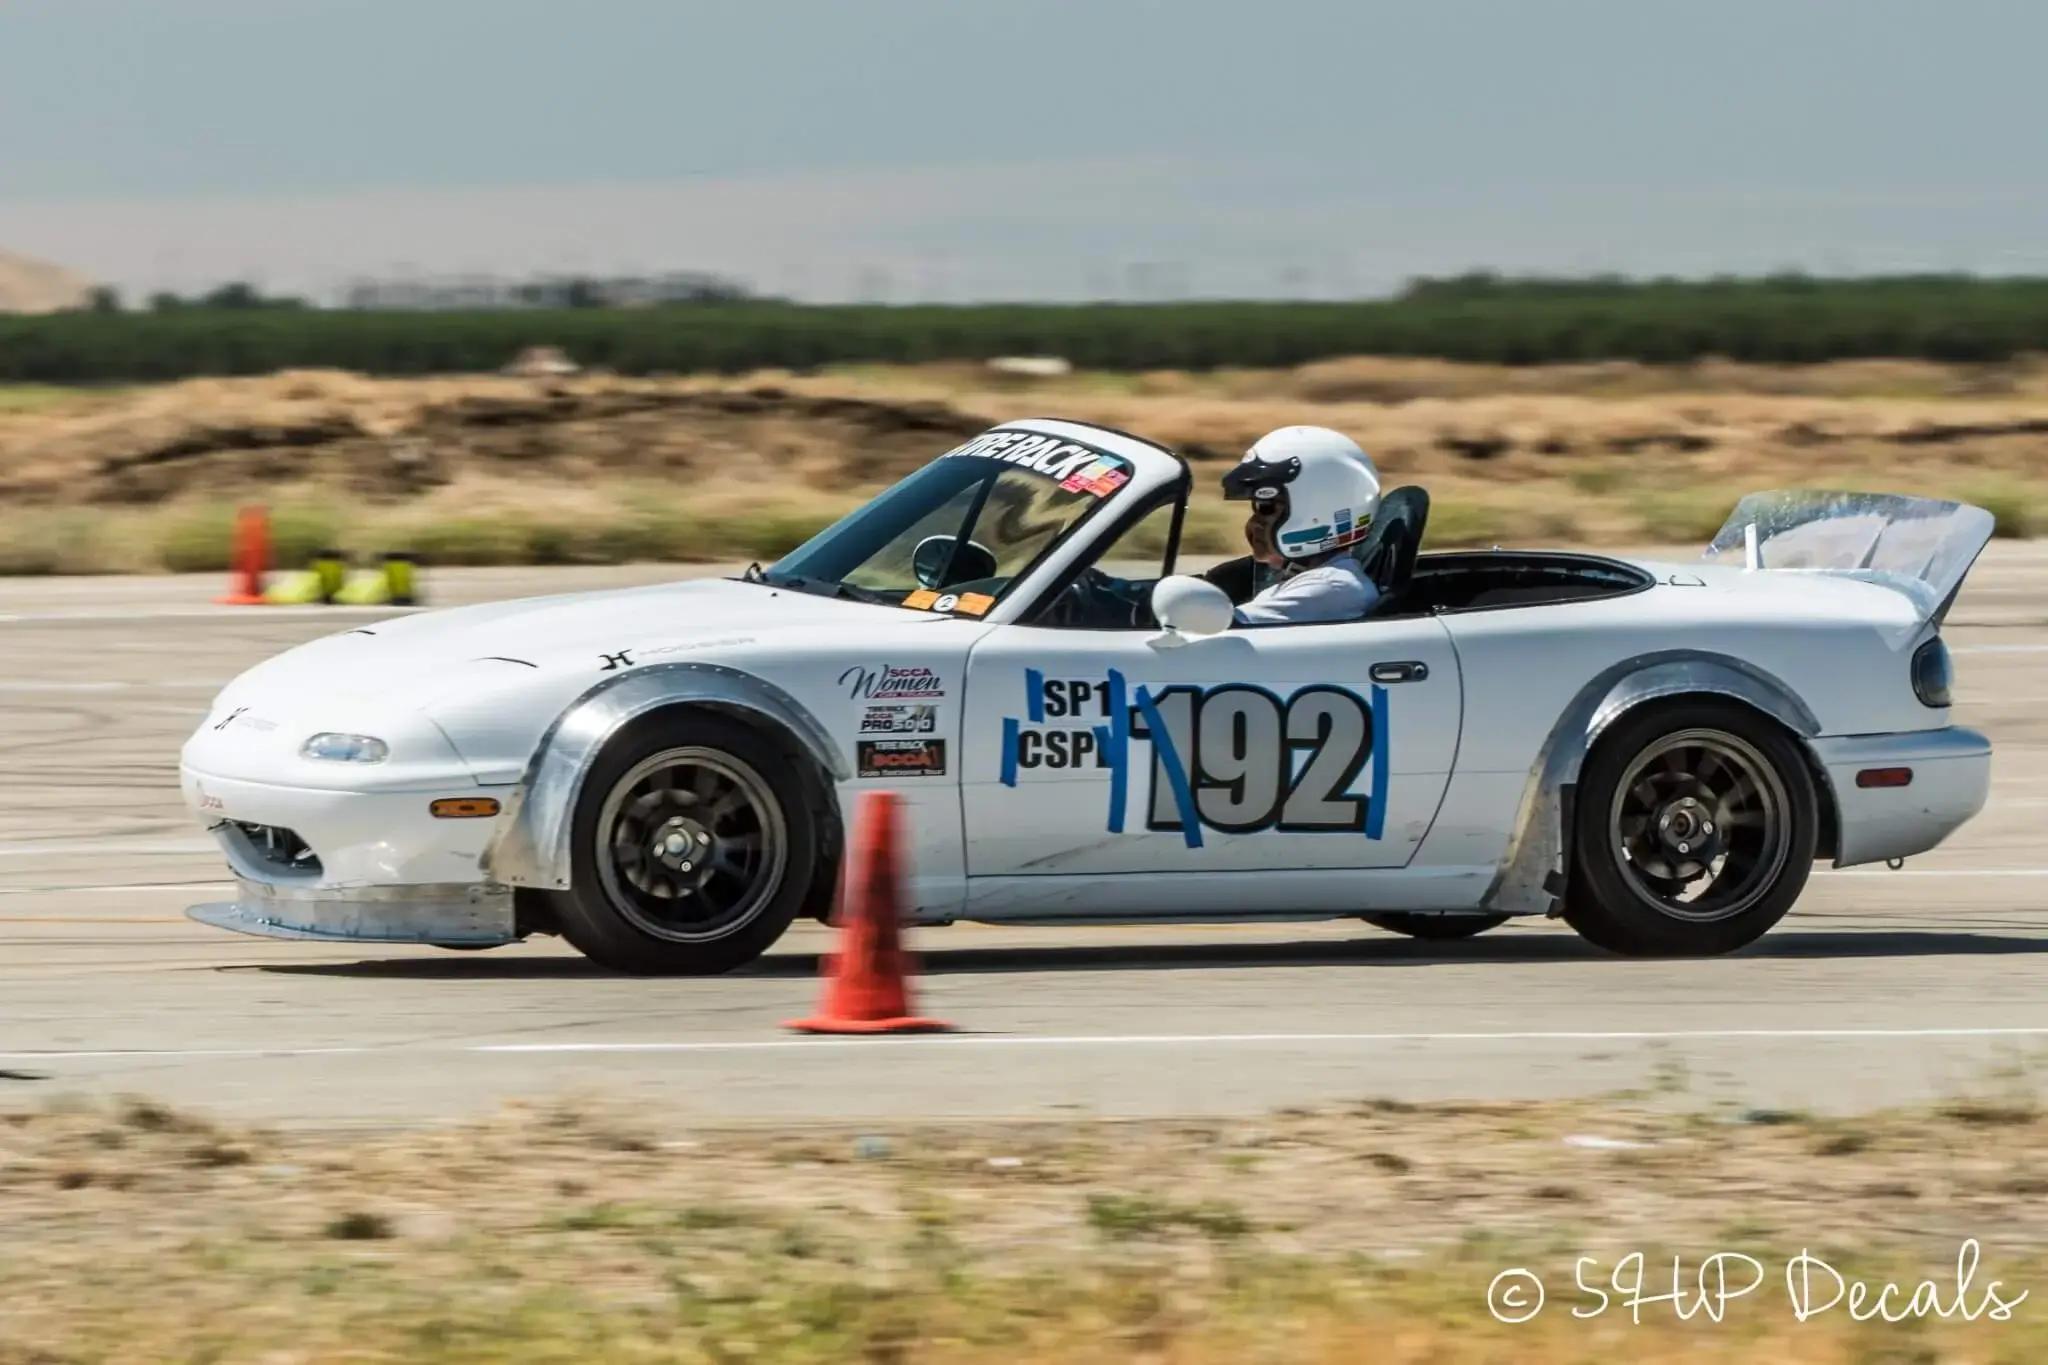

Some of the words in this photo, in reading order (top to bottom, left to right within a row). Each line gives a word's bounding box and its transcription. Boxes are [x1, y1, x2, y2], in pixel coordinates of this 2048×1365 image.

[838, 664, 942, 700] Women
[889, 668, 933, 677] SCCA
[1043, 680, 1112, 717] SP1
[1128, 682, 1373, 834] 192
